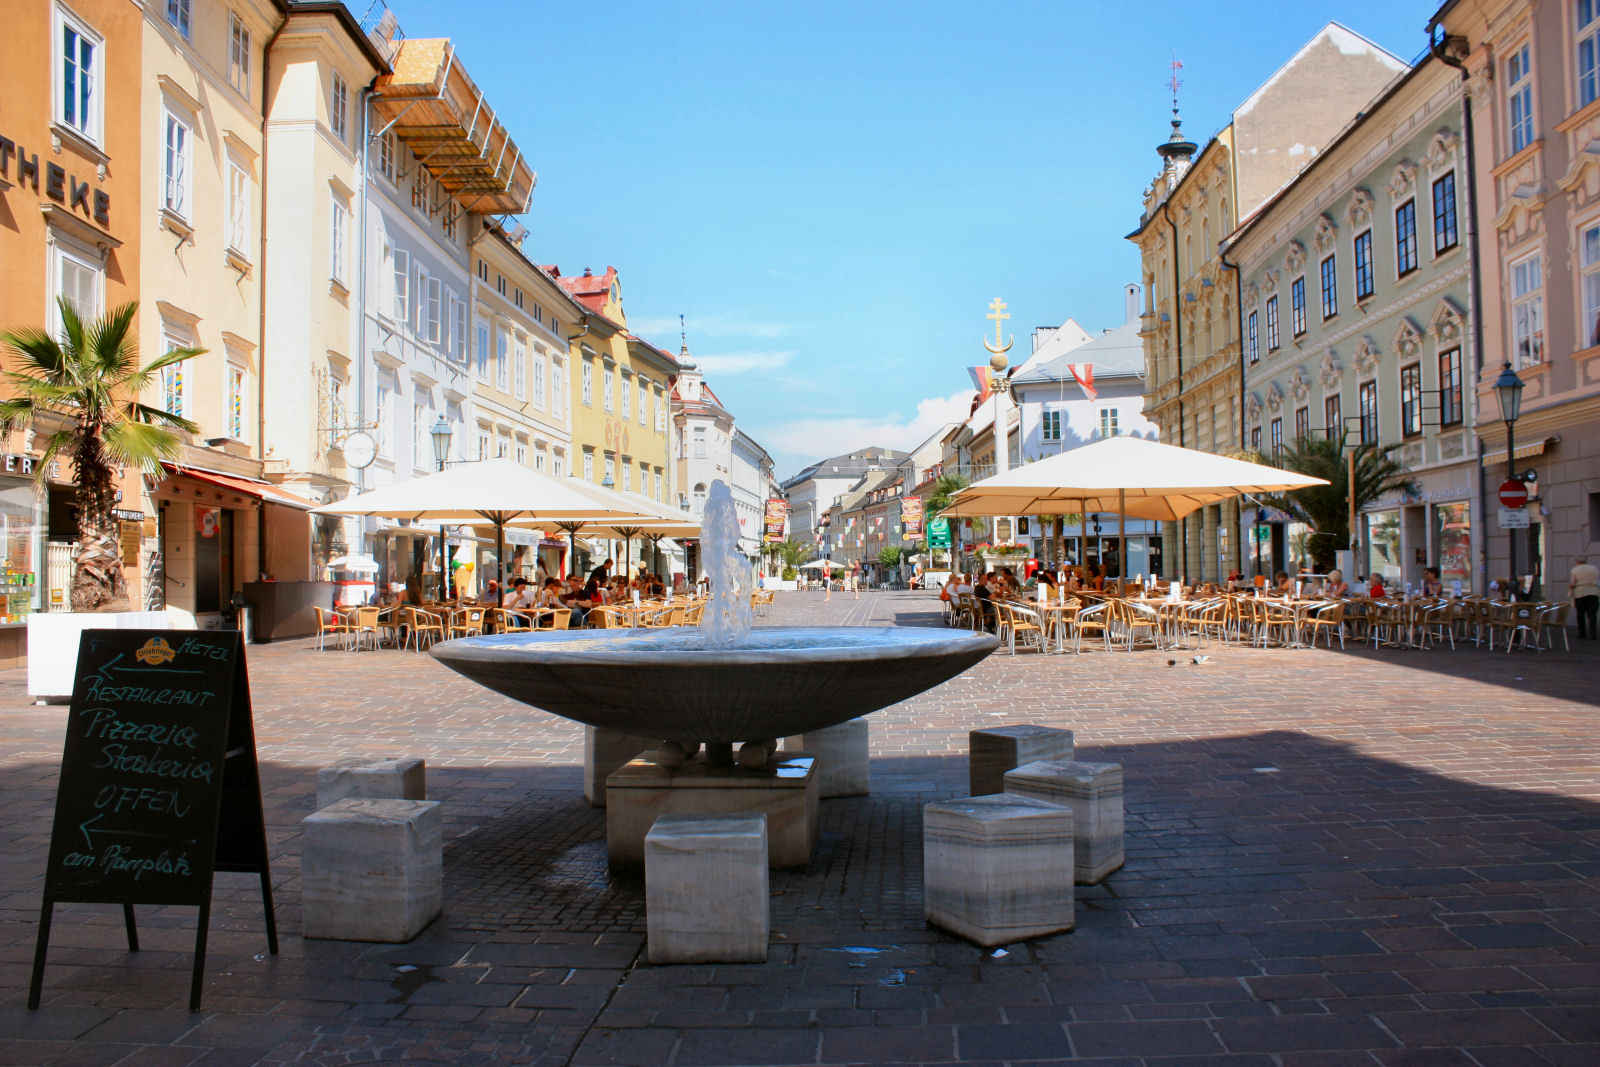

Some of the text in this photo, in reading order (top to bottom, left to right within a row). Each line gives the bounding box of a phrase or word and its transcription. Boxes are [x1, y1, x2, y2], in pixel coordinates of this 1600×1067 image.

[0, 135, 110, 230] THEKE
[82, 674, 216, 706] RESTAURANT
[94, 784, 191, 818] OFFEN
[63, 851, 97, 867] am
